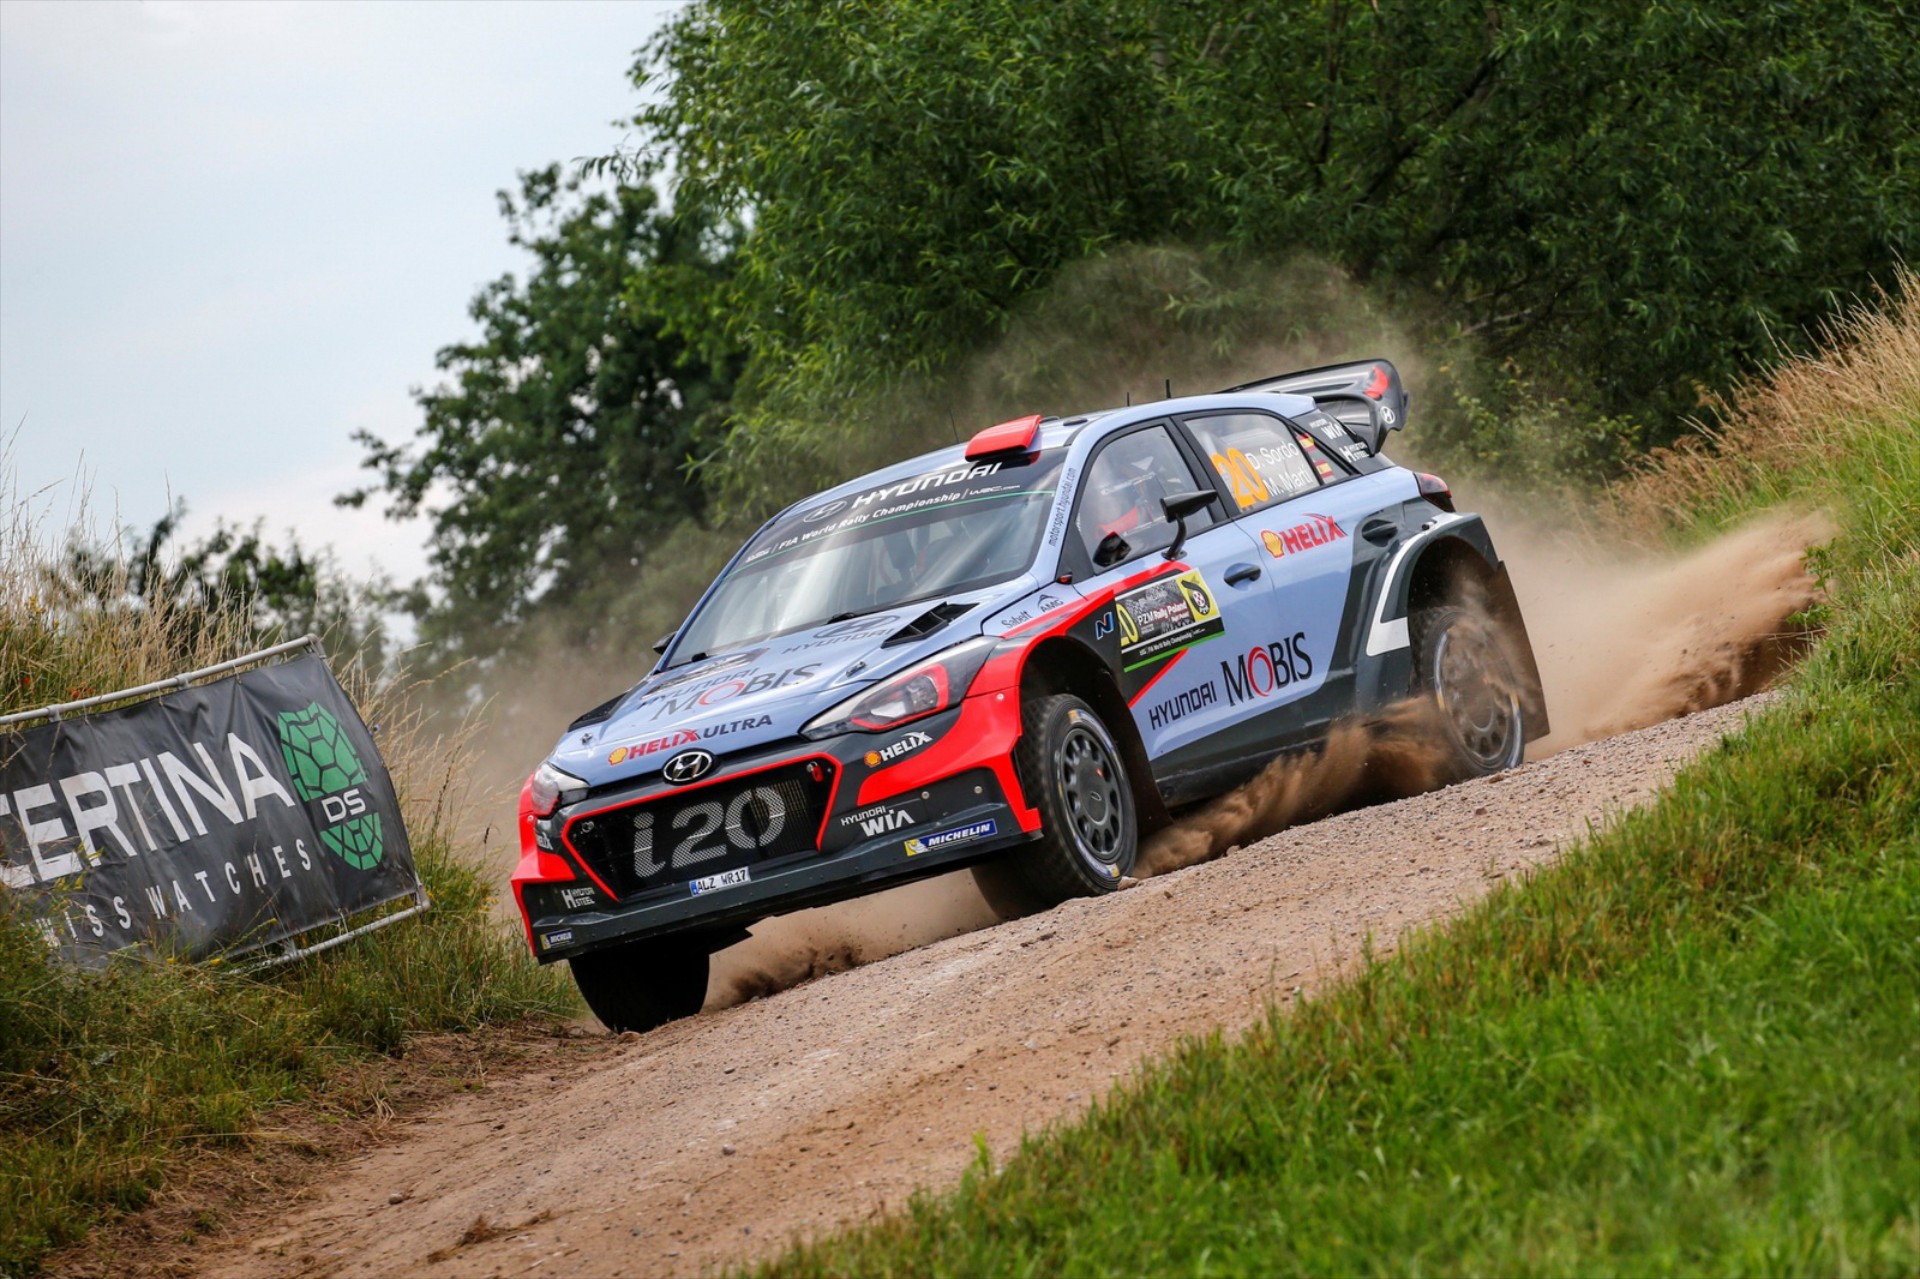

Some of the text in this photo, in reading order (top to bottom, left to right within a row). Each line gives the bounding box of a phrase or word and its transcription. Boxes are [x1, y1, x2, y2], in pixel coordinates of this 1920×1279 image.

[1245, 440, 1299, 470] D. Sordo
[852, 462, 1002, 509] HYUNDAI
[1210, 448, 1270, 508] 20
[1263, 477, 1285, 497] M.
[778, 537, 799, 550] FIA
[802, 523, 837, 541] World
[838, 514, 869, 529] Rally
[872, 492, 961, 518] Championship
[1048, 467, 1077, 547] motorsport.hyundai.com
[1280, 513, 1348, 554] HELIX
[1001, 611, 1032, 629] Sabelt
[1115, 602, 1139, 646] 0
[782, 628, 893, 655] HYUNDAI
[651, 662, 823, 721] MOBIS
[1149, 632, 1313, 730] HYUNDAI MOBIS
[629, 714, 773, 760] HELIX ULTRA
[880, 731, 934, 761] HELIX
[321, 788, 366, 824] DS
[840, 805, 886, 827] HYUNDAI
[860, 809, 915, 837] WIA
[634, 786, 786, 879] i20
[928, 823, 991, 847] MICHELIN
[145, 839, 311, 919] WATCHES
[697, 869, 746, 890] ALZ WR17
